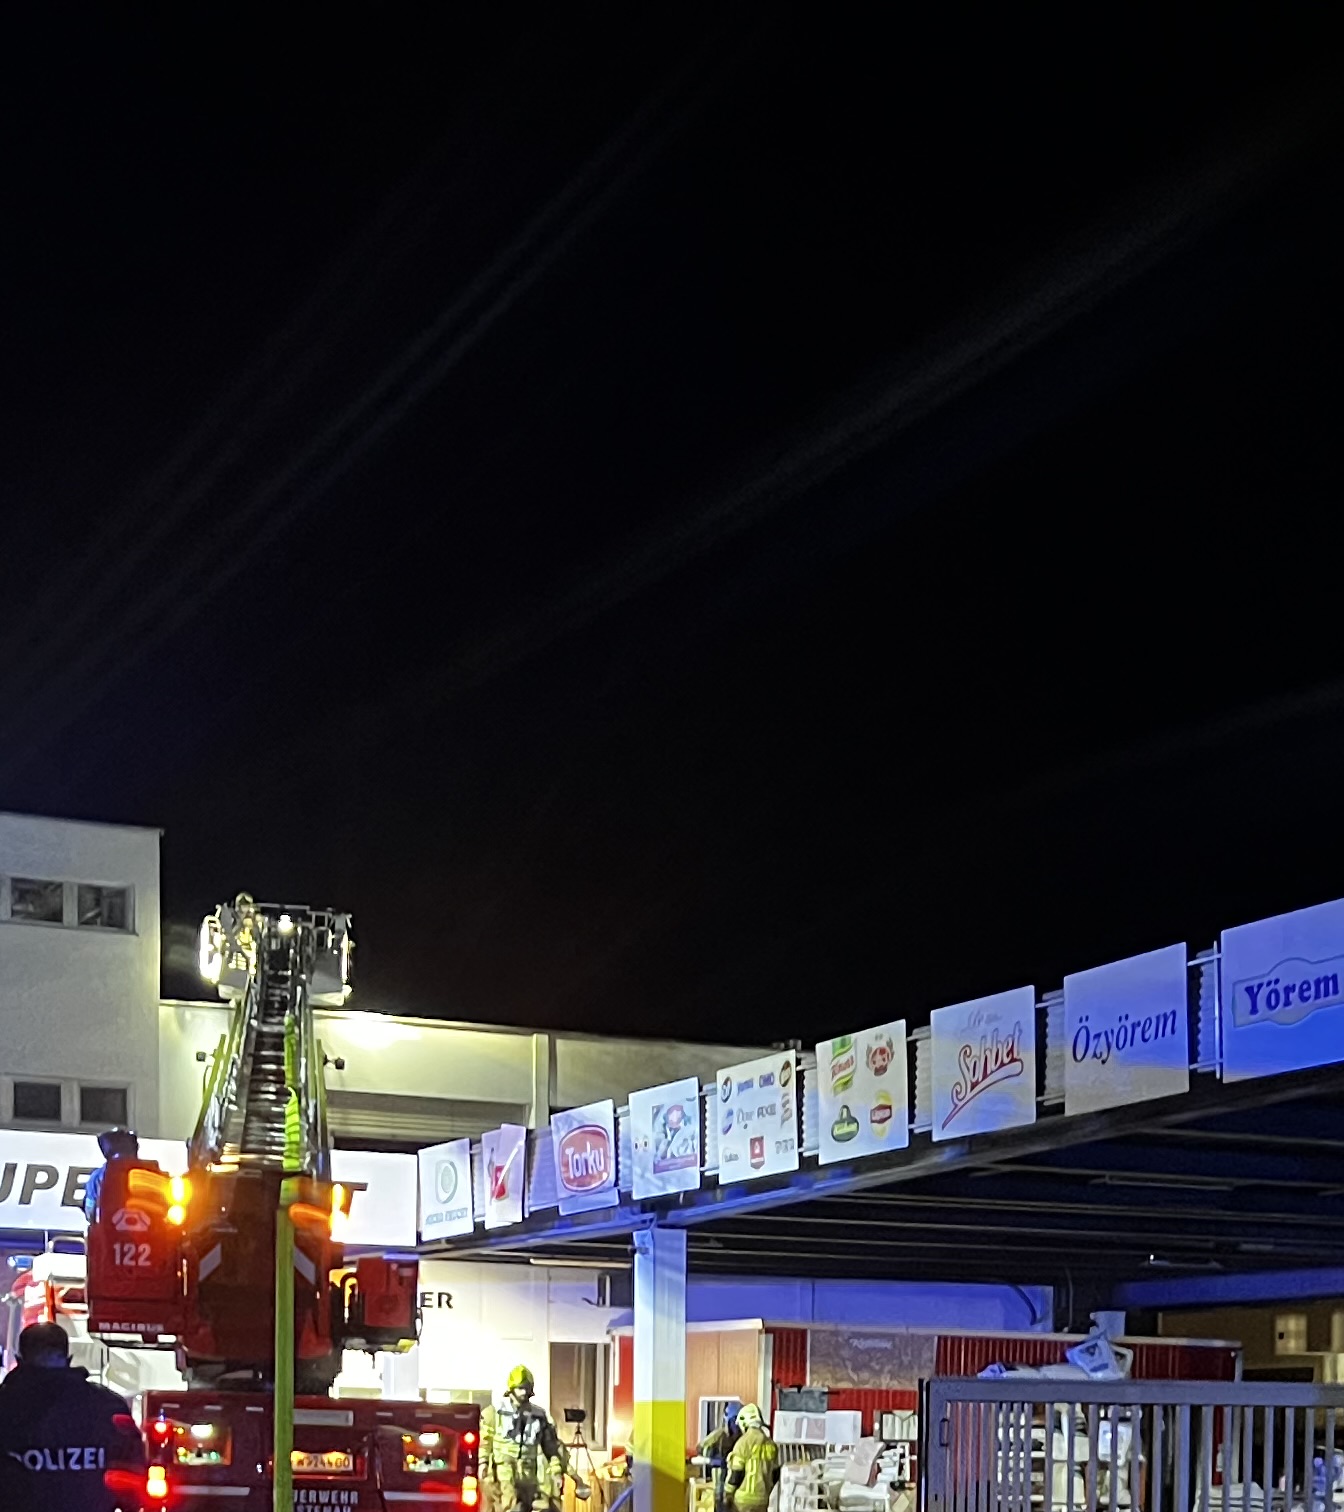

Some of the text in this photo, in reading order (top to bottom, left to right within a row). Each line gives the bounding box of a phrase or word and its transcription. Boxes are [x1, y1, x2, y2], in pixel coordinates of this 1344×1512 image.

[1244, 973, 1340, 1017] Yörem
[1072, 1009, 1178, 1064] Özyörem
[951, 1020, 1023, 1101] Sohbet
[565, 1140, 605, 1179] Torku
[114, 1243, 151, 1266] 122
[98, 1322, 164, 1332] MAGIRUS
